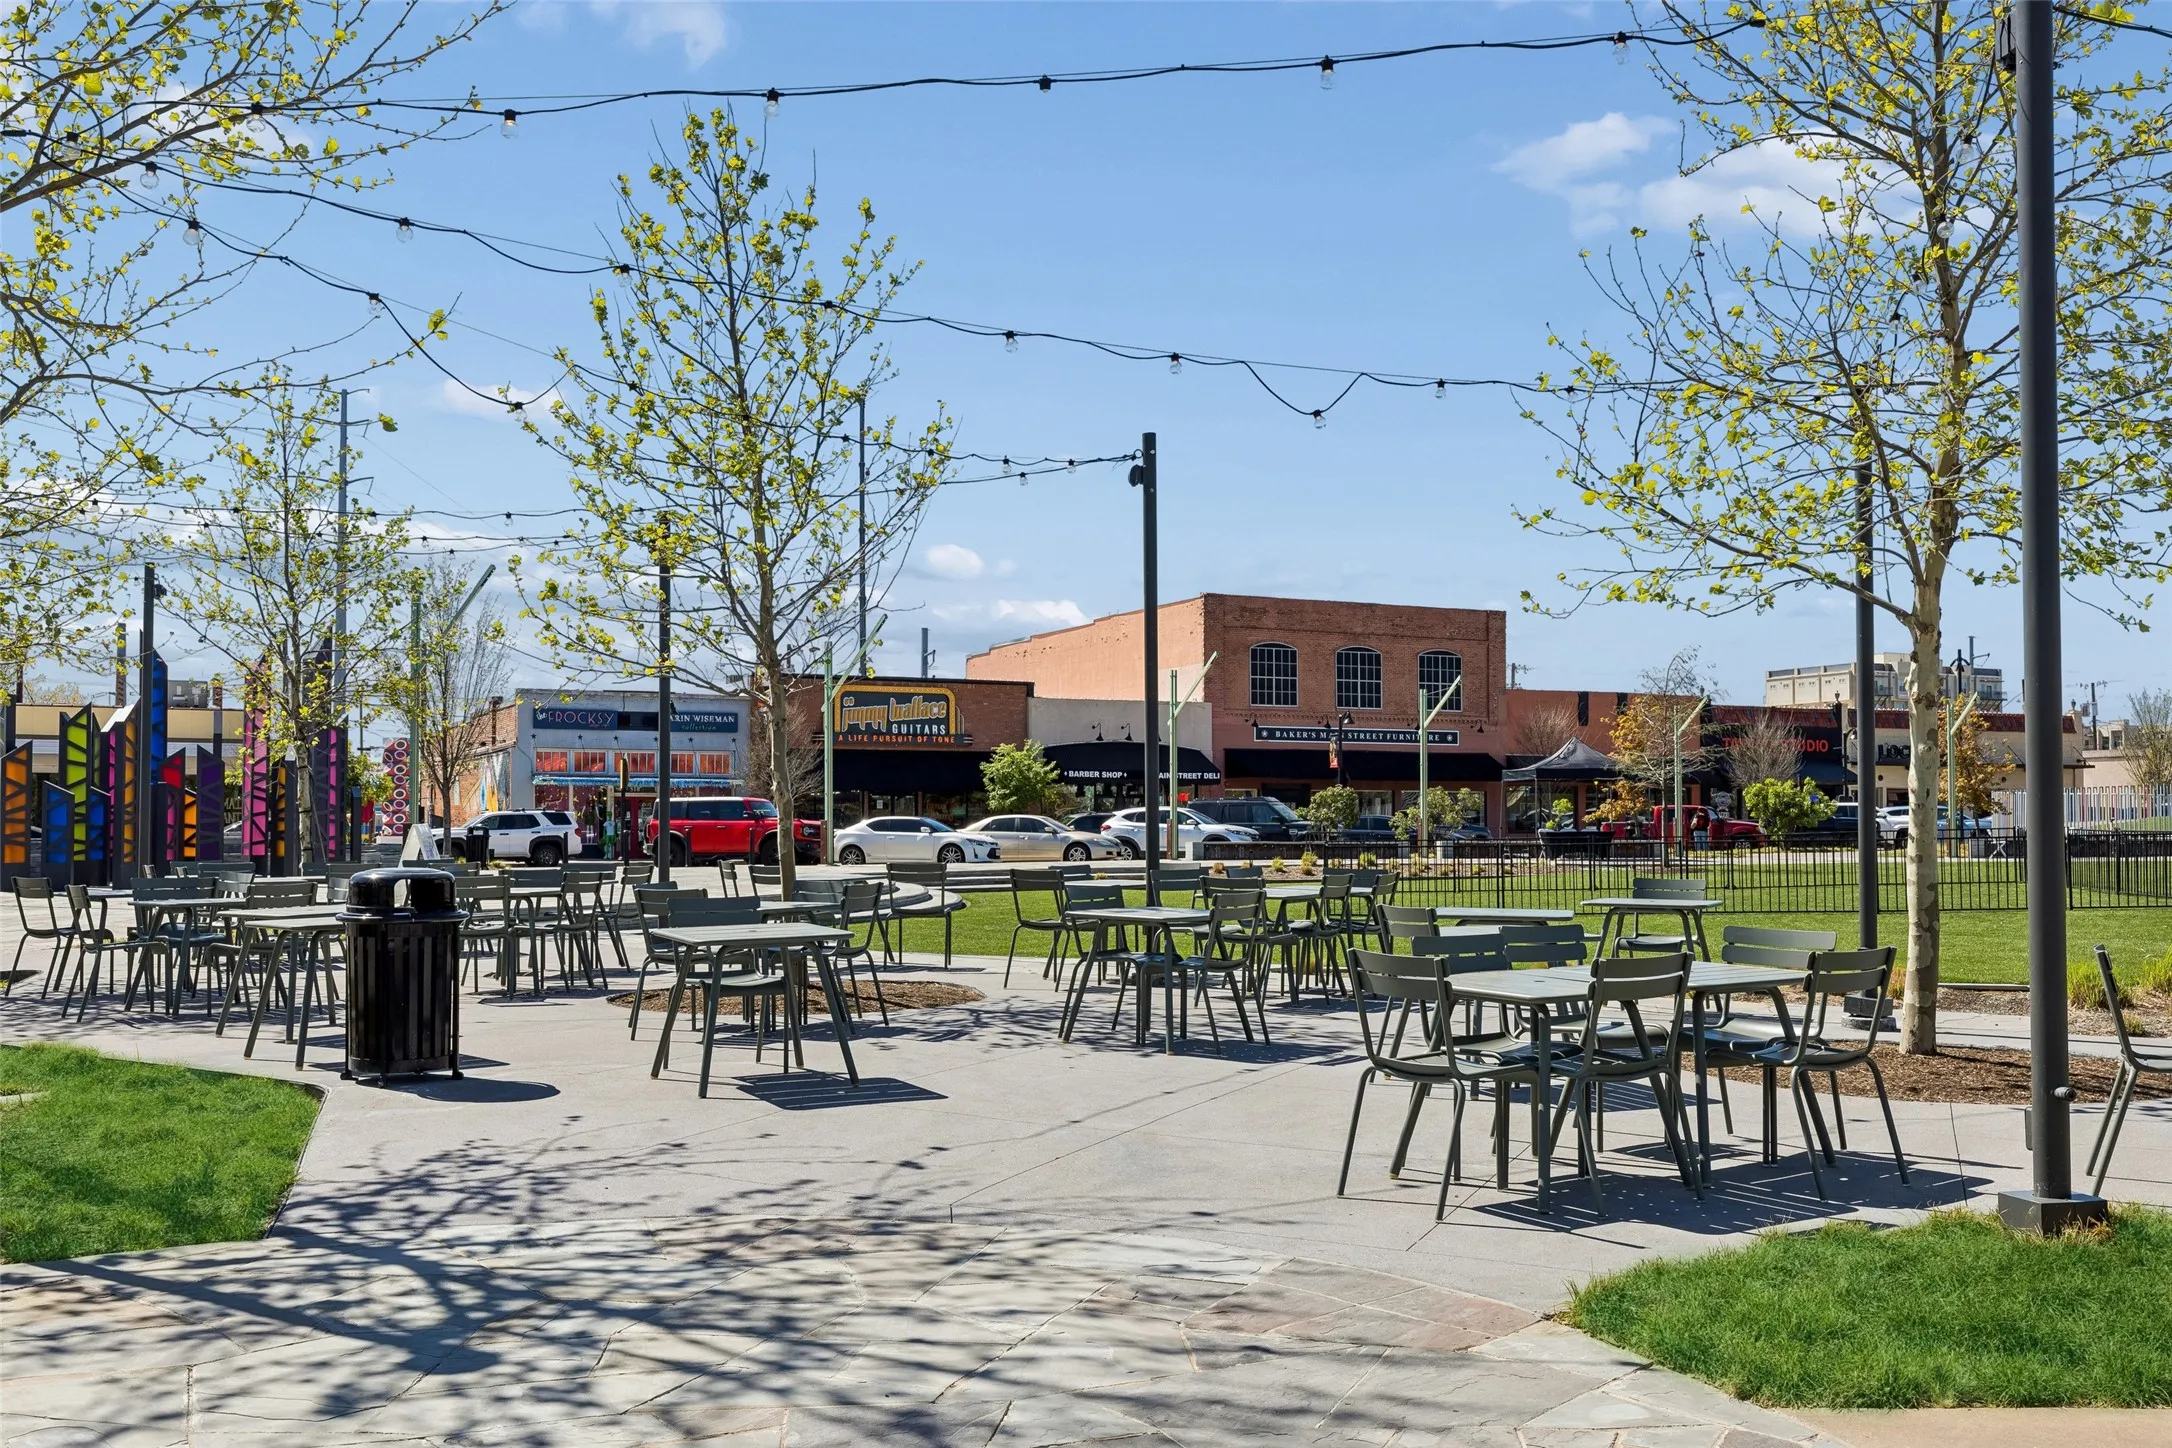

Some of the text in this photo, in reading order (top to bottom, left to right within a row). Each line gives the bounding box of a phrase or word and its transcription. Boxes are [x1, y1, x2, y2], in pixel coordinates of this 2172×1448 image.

[548, 711, 615, 724] FROCKSY
[669, 714, 735, 723] ARIN WISEMAN
[842, 696, 947, 732] jimmy wallace
[681, 723, 717, 731] collection
[892, 724, 946, 735] GUITARS
[1069, 770, 1100, 778] BARBER
